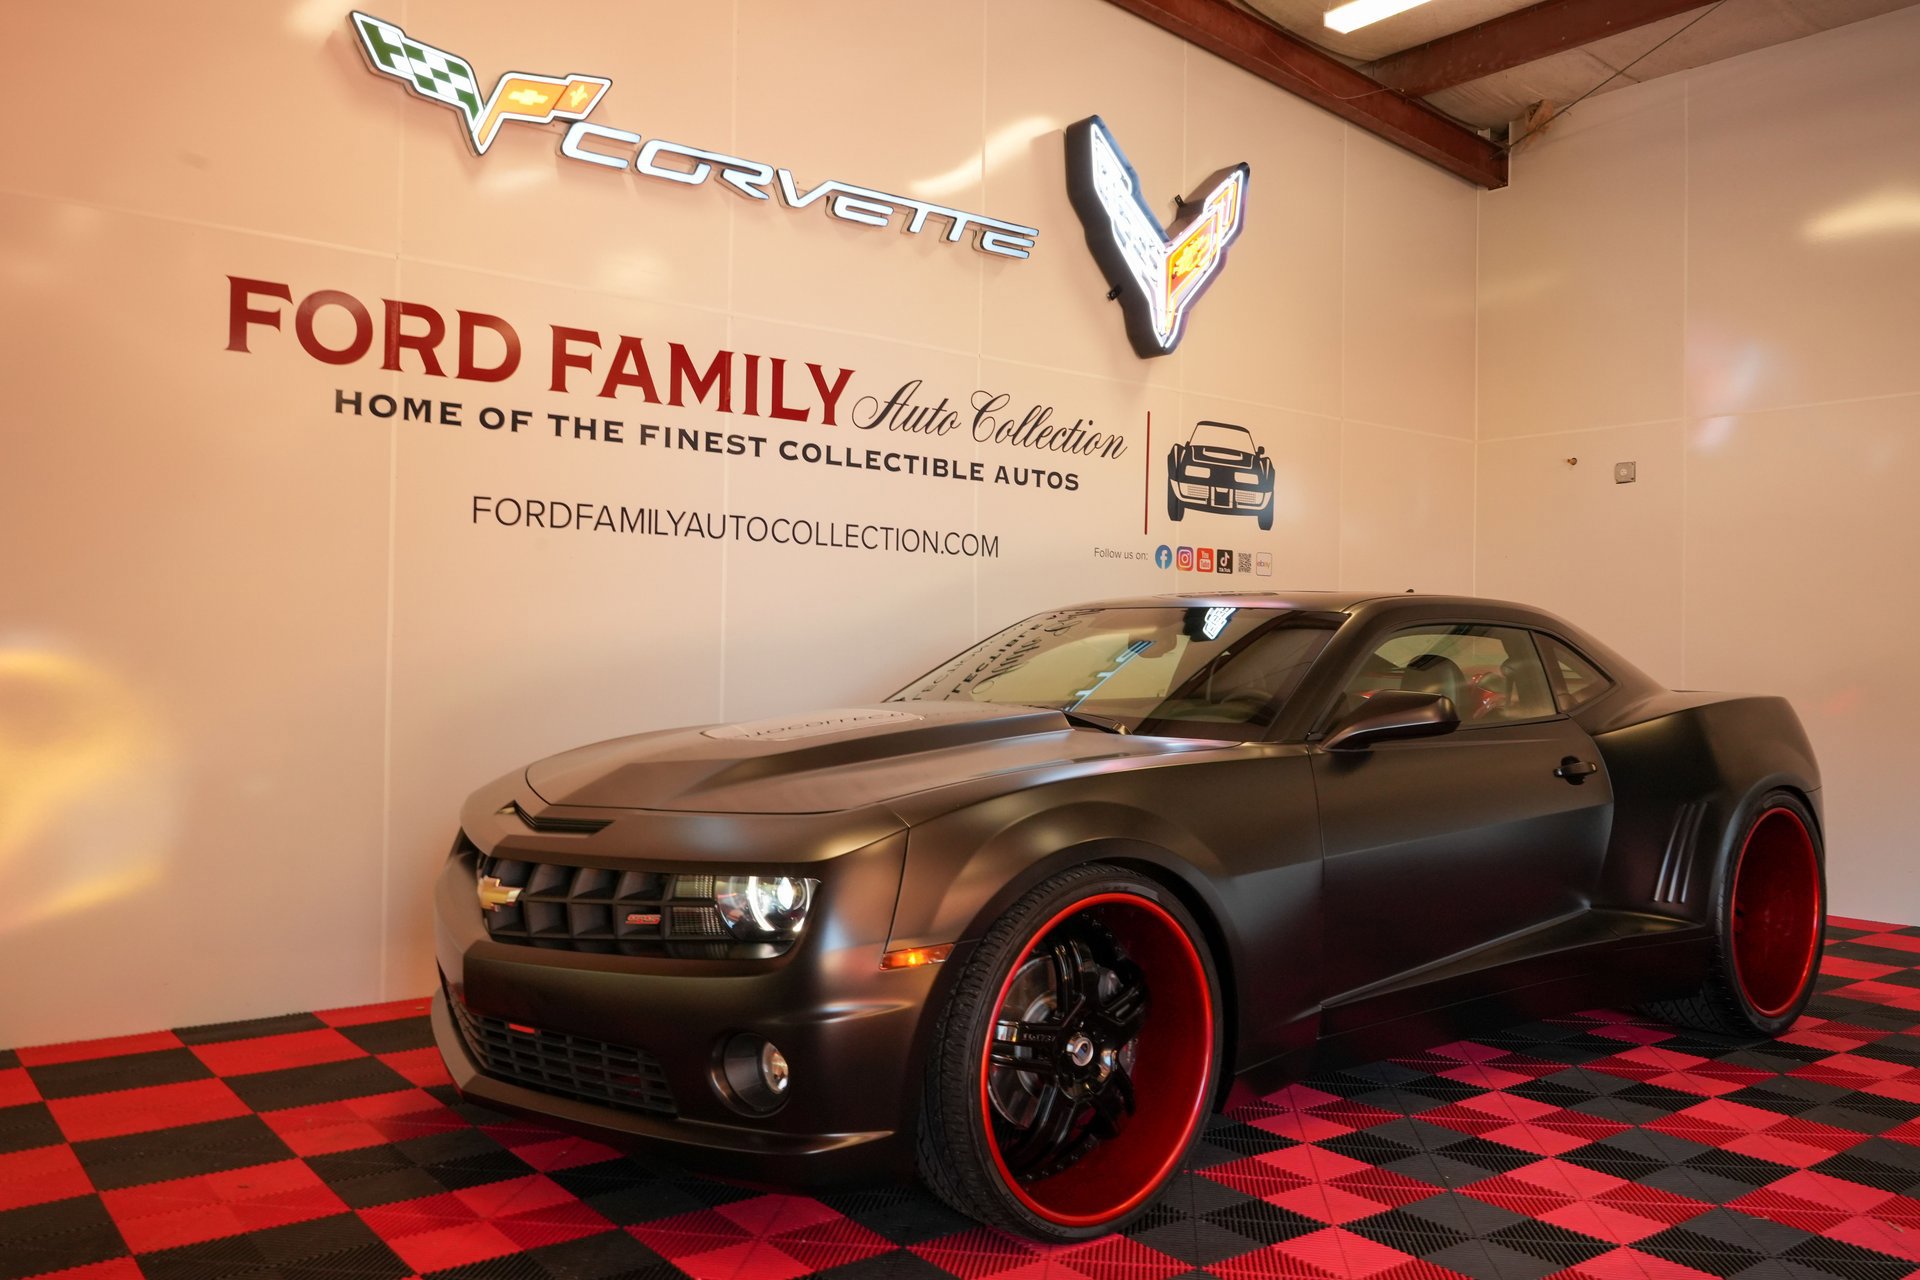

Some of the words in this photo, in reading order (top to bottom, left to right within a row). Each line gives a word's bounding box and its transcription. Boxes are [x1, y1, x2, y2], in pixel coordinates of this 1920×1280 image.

[560, 121, 1040, 259] CORVETTE
[225, 275, 522, 383] FORD
[548, 324, 854, 427] FAMILY
[851, 379, 962, 435] Auto
[970, 390, 1128, 460] Collection
[335, 389, 463, 427] HOME
[479, 407, 533, 433] OF
[547, 413, 625, 444] THE
[640, 424, 768, 458] FINEST
[778, 440, 985, 482] COLLECTIBLE
[993, 465, 1080, 491] AUTOS
[473, 495, 1000, 558] FORDFAMILYAUTOCOLLECTION.COM
[1094, 547, 1121, 559] Follow
[1124, 551, 1133, 560] us
[1136, 552, 1149, 561] on:
